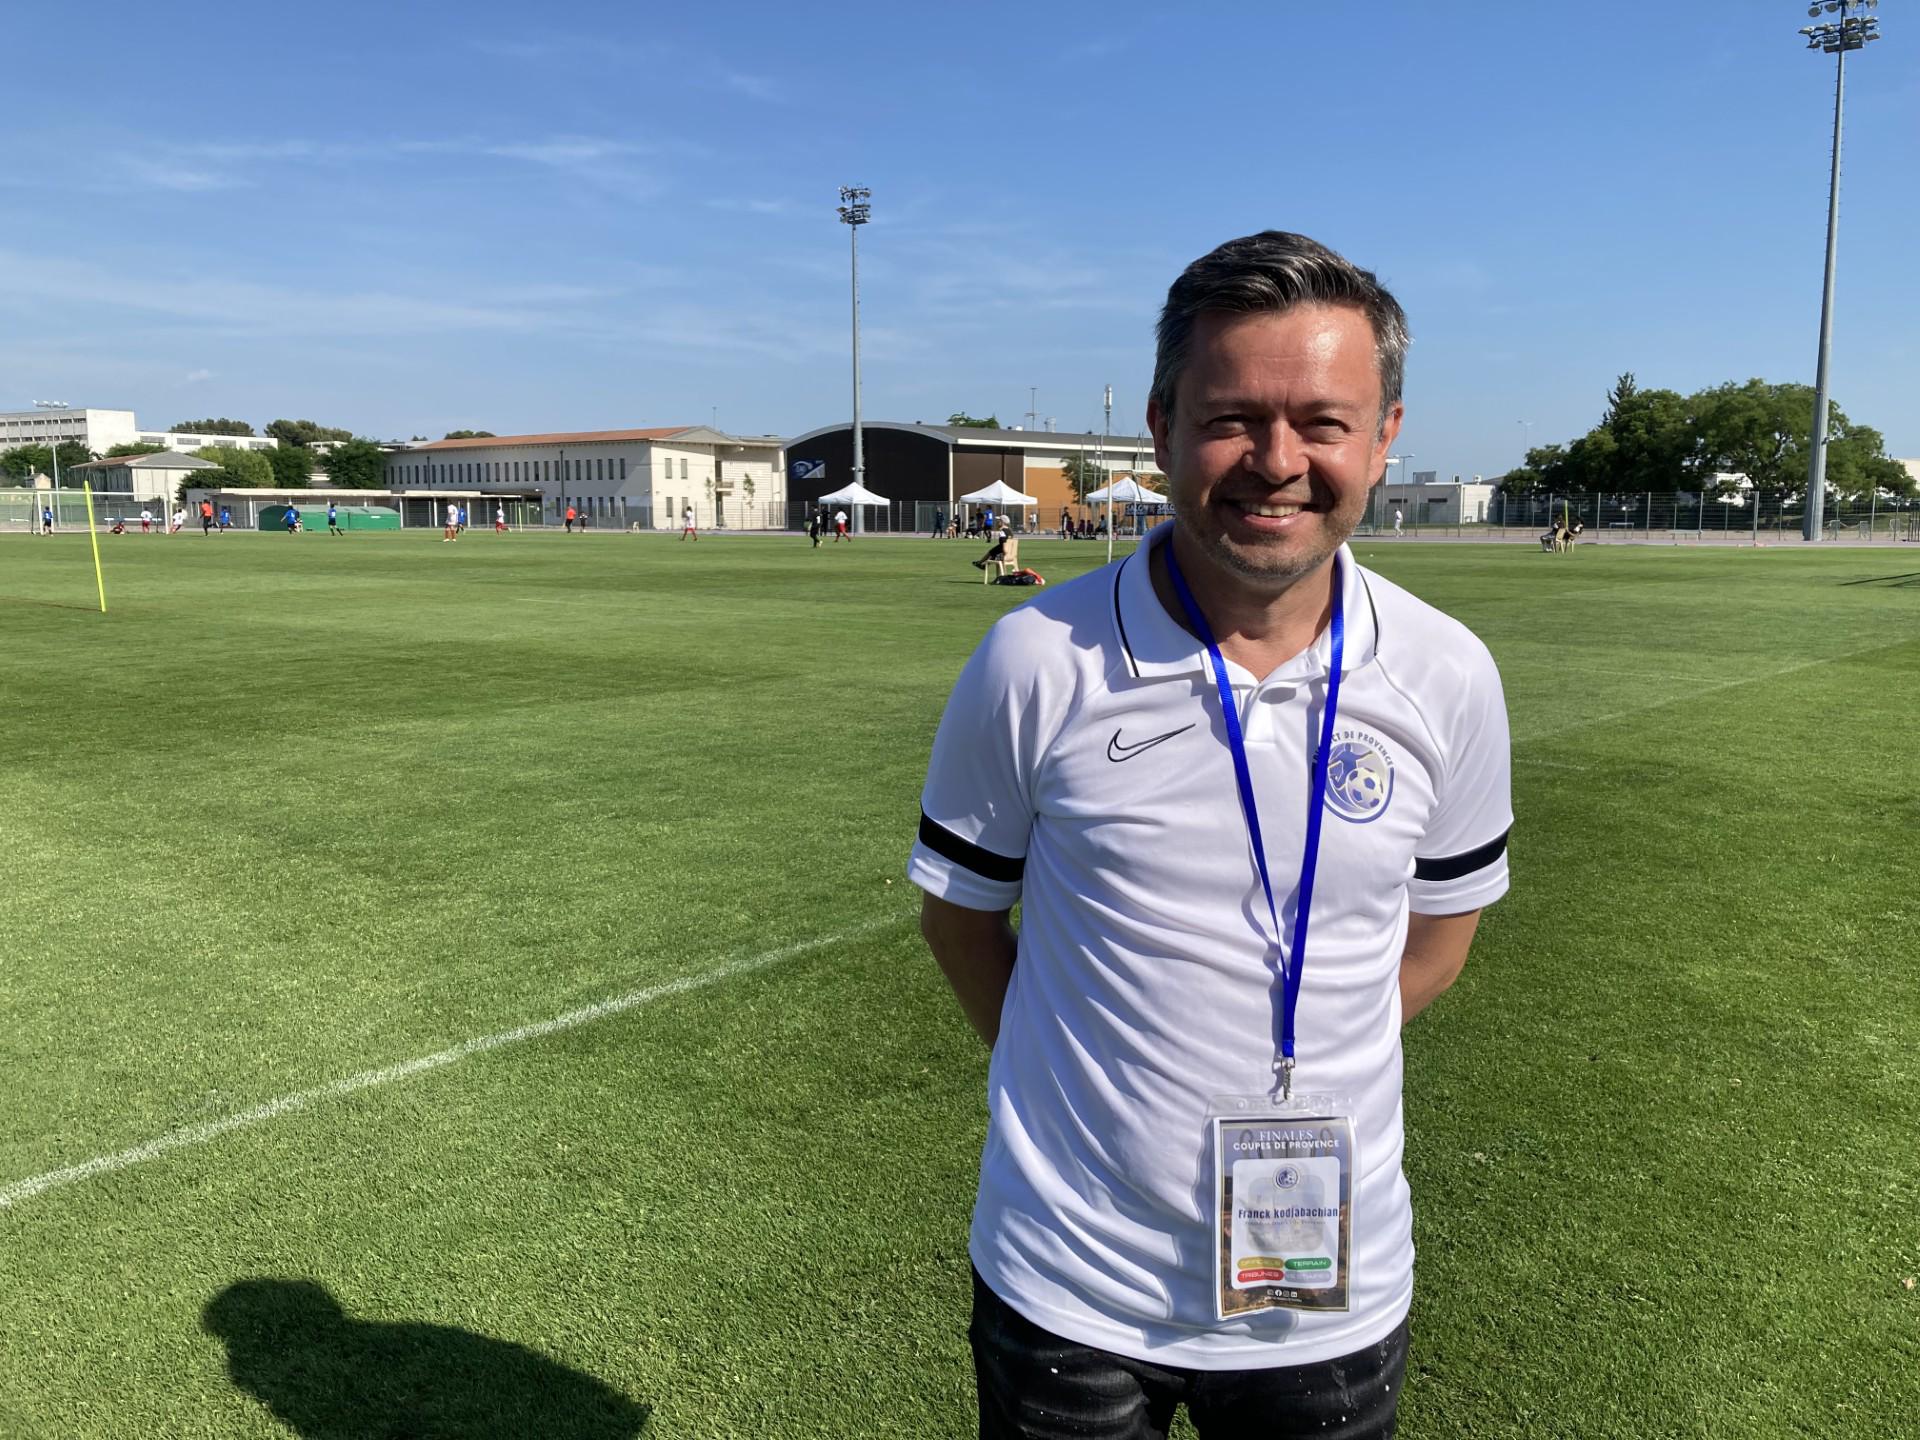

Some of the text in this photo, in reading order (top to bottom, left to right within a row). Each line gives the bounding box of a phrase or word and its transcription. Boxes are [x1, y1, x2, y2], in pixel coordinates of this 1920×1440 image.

[1358, 732, 1393, 766] PROVENCE
[1260, 1130, 1314, 1142] FINALES
[1233, 1139, 1340, 1151] COUPES DE PROVENCE
[1238, 1209, 1271, 1219] Franck
